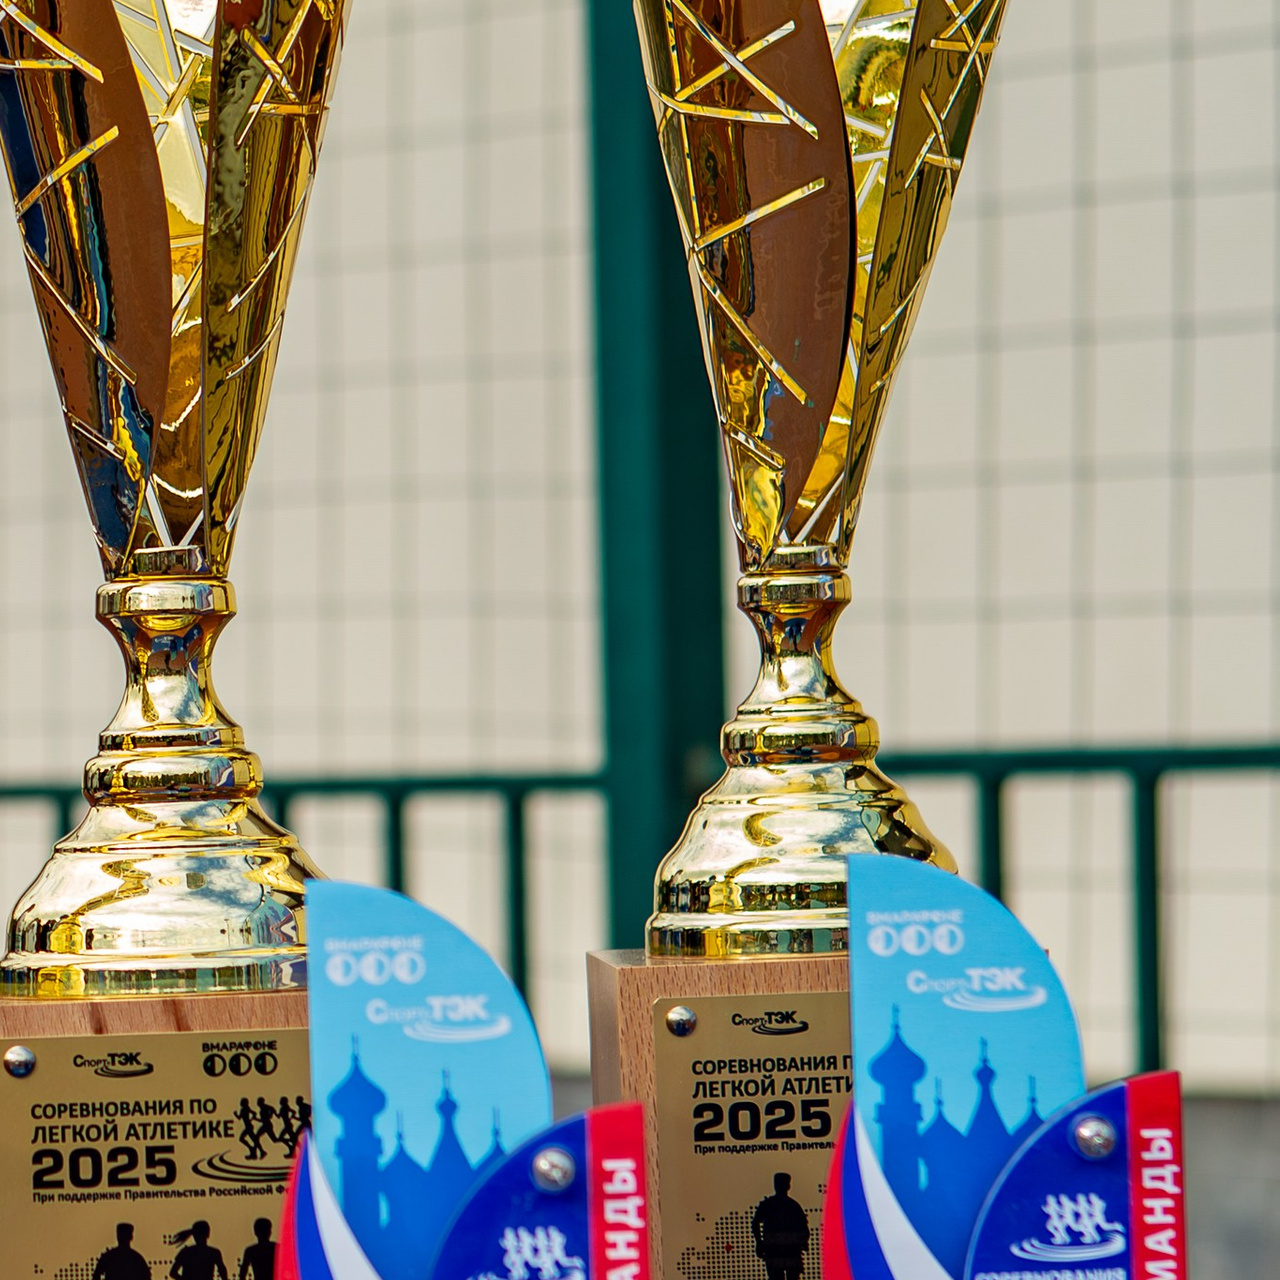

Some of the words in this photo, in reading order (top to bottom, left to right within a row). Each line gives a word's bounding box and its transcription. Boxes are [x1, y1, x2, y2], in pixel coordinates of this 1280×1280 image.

[202, 1040, 277, 1052] ВМАРАФОНЕ
[691, 1055, 837, 1075] СОРЕВНОВАНИЯ
[692, 1074, 775, 1098] ЛЕГКОЙ
[30, 1100, 184, 1120] СОРЕВНОВАНИЯ
[190, 1098, 217, 1116] ПО
[31, 1118, 118, 1144] ЛЕГКОЙ
[124, 1120, 235, 1142] АТЛЕТИКЕ
[692, 1099, 832, 1142] 2025
[694, 1145, 715, 1155] При
[718, 1143, 779, 1154] поддержке
[32, 1145, 177, 1190] 2025
[33, 1192, 54, 1204] При
[57, 1190, 121, 1204] поддержке
[124, 1187, 207, 1201] Правительства
[209, 1184, 273, 1198] Российской
